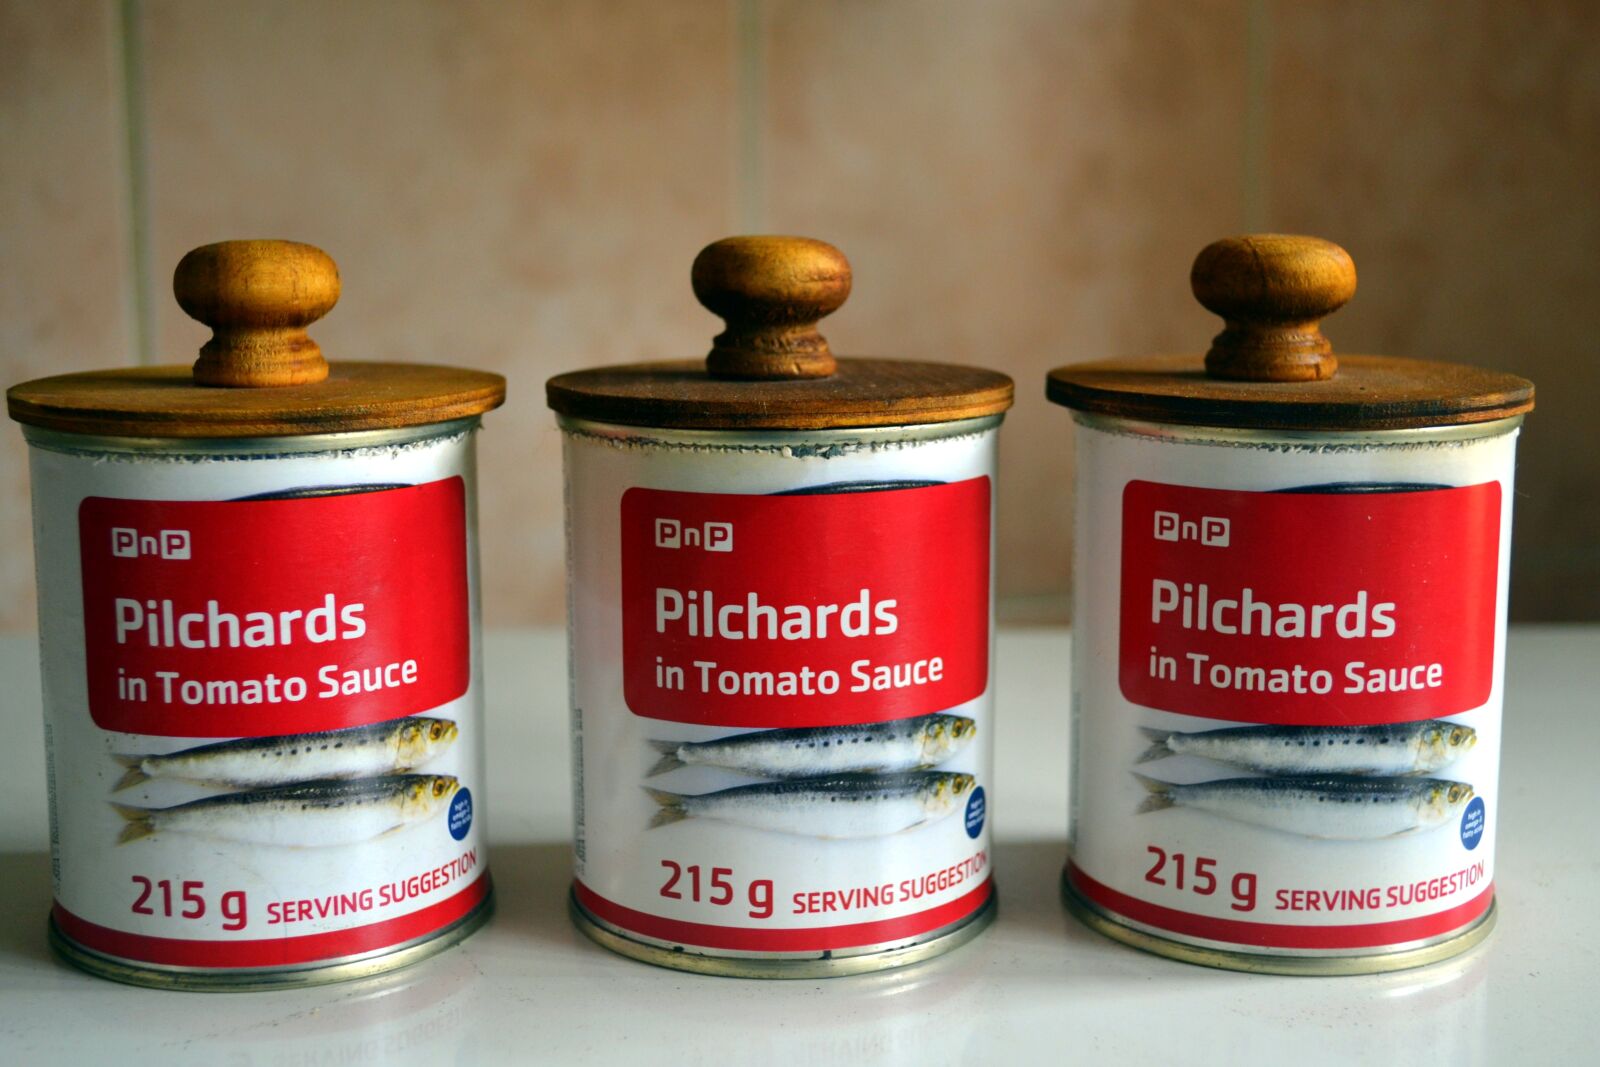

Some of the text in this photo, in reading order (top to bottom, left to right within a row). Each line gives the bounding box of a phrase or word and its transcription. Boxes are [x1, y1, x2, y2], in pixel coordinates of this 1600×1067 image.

[111, 527, 191, 560] PnP
[655, 518, 733, 552] PnP
[1153, 510, 1230, 547] PnP
[115, 593, 367, 649] Pilchards
[656, 588, 898, 640] Pilchards
[1152, 578, 1396, 639] Pilchards
[118, 659, 418, 705] in Tomato Sauce
[656, 656, 943, 695] in Tomato Sauce
[1150, 646, 1443, 694] in Tomato Sauce
[131, 875, 248, 931] 215 g
[267, 848, 477, 925] SERVING SUGGESTION
[660, 860, 774, 919] 215 g
[792, 850, 988, 914] SERVING SUGGESTION
[1145, 846, 1257, 912] 215 g
[1275, 860, 1484, 911] SERVING SUGGESTION
